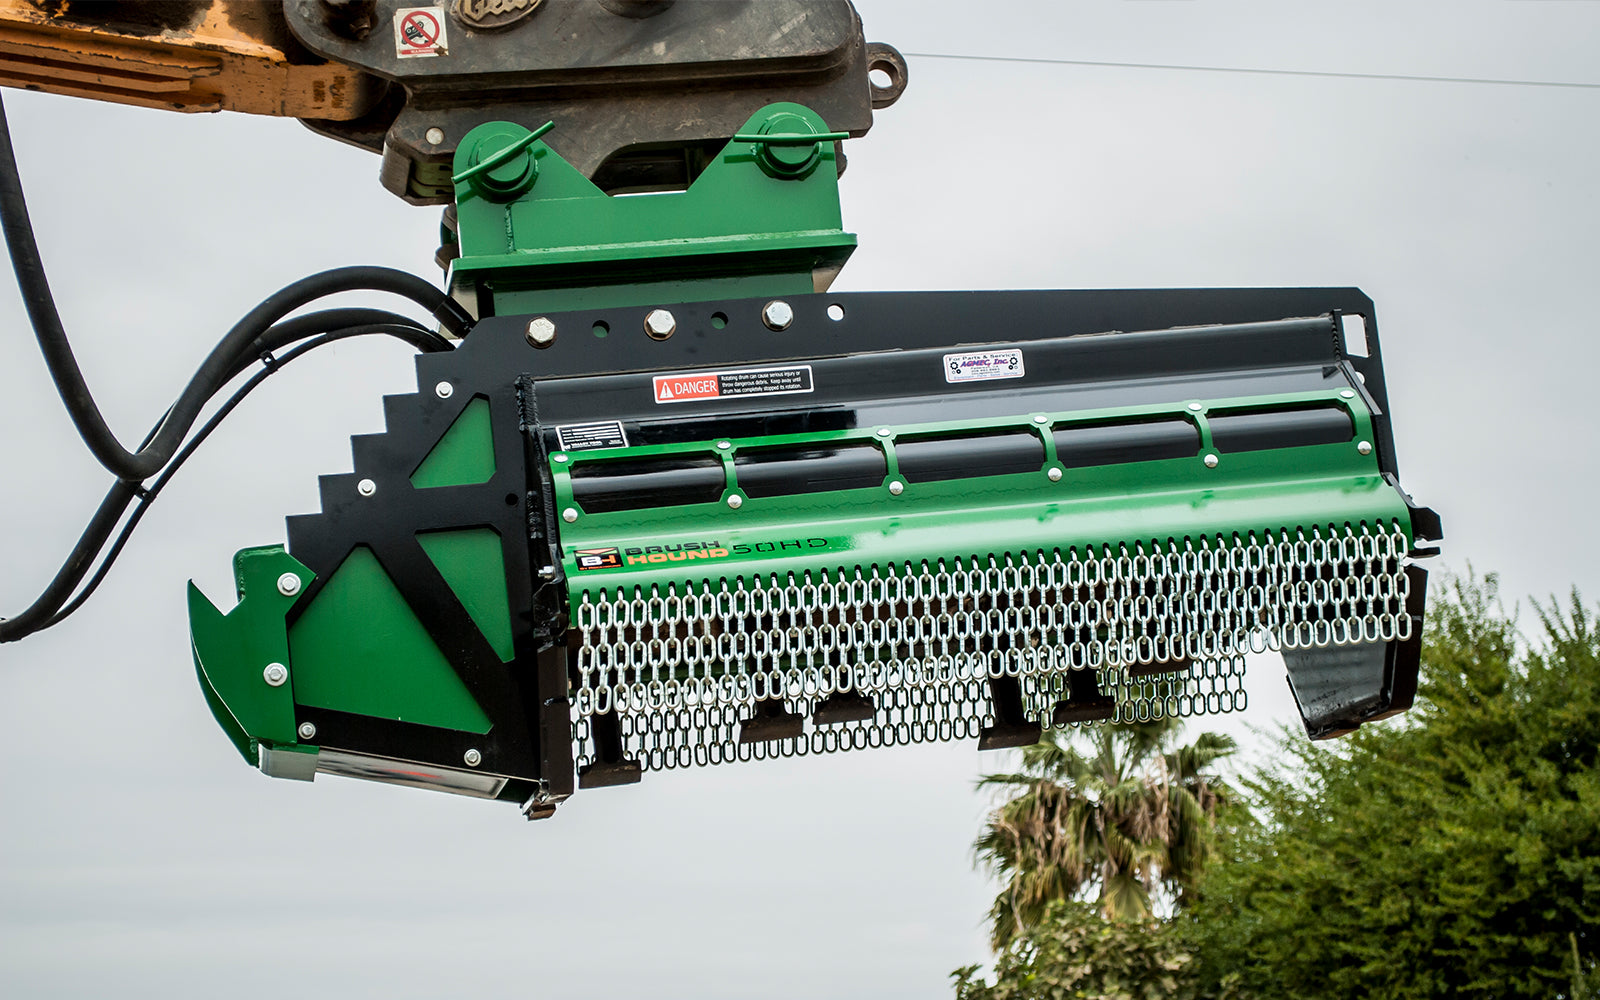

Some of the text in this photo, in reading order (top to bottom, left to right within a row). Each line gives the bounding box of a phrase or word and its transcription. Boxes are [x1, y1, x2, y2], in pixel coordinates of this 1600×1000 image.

[674, 380, 718, 395] DANGER
[624, 541, 720, 556] BRUSH
[733, 538, 828, 554] 50HD
[627, 548, 729, 565] HOUND
